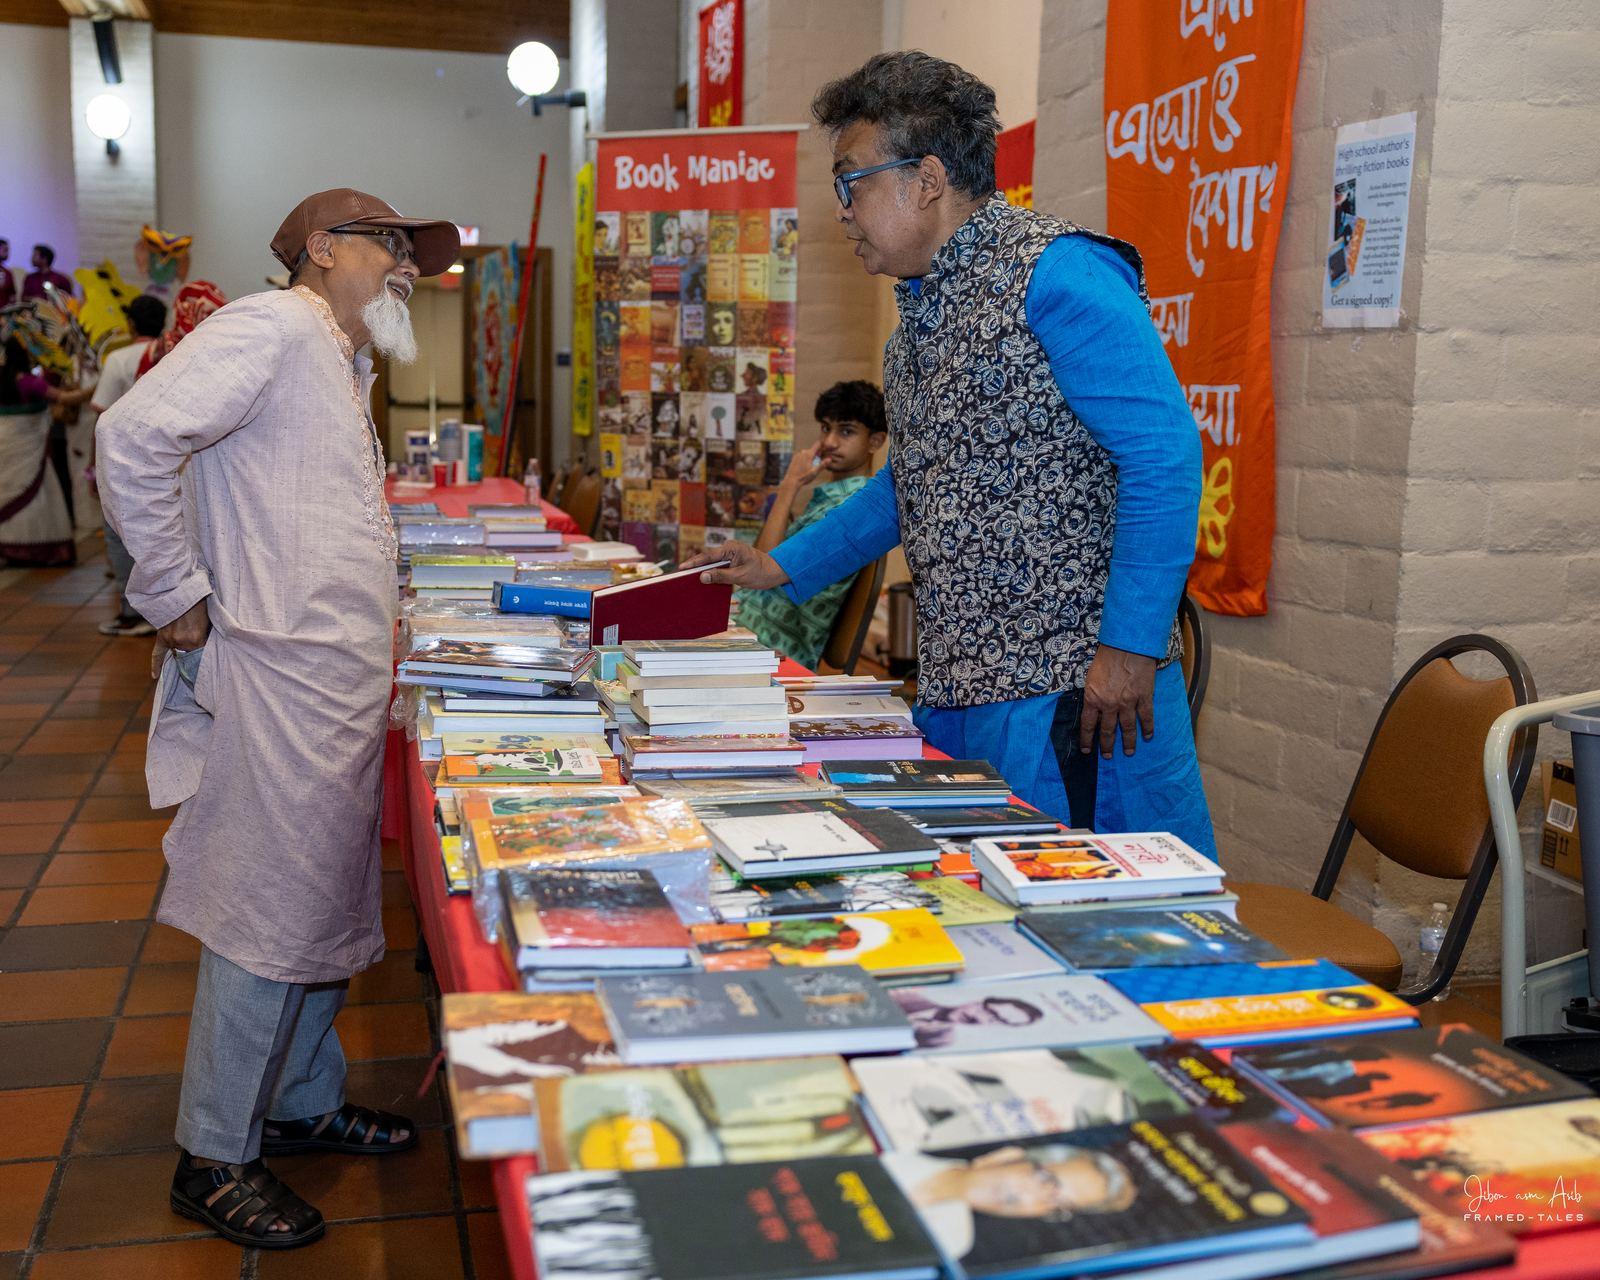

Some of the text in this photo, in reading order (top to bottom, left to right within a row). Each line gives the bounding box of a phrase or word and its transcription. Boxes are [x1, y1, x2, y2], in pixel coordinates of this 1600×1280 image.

[1355, 143, 1379, 157] school
[1379, 138, 1410, 153] author's
[614, 150, 775, 193] Book Maniac
[1363, 160, 1386, 173] fiction
[1386, 156, 1410, 169] books
[1331, 294, 1345, 306] Get
[1350, 293, 1373, 309] signed
